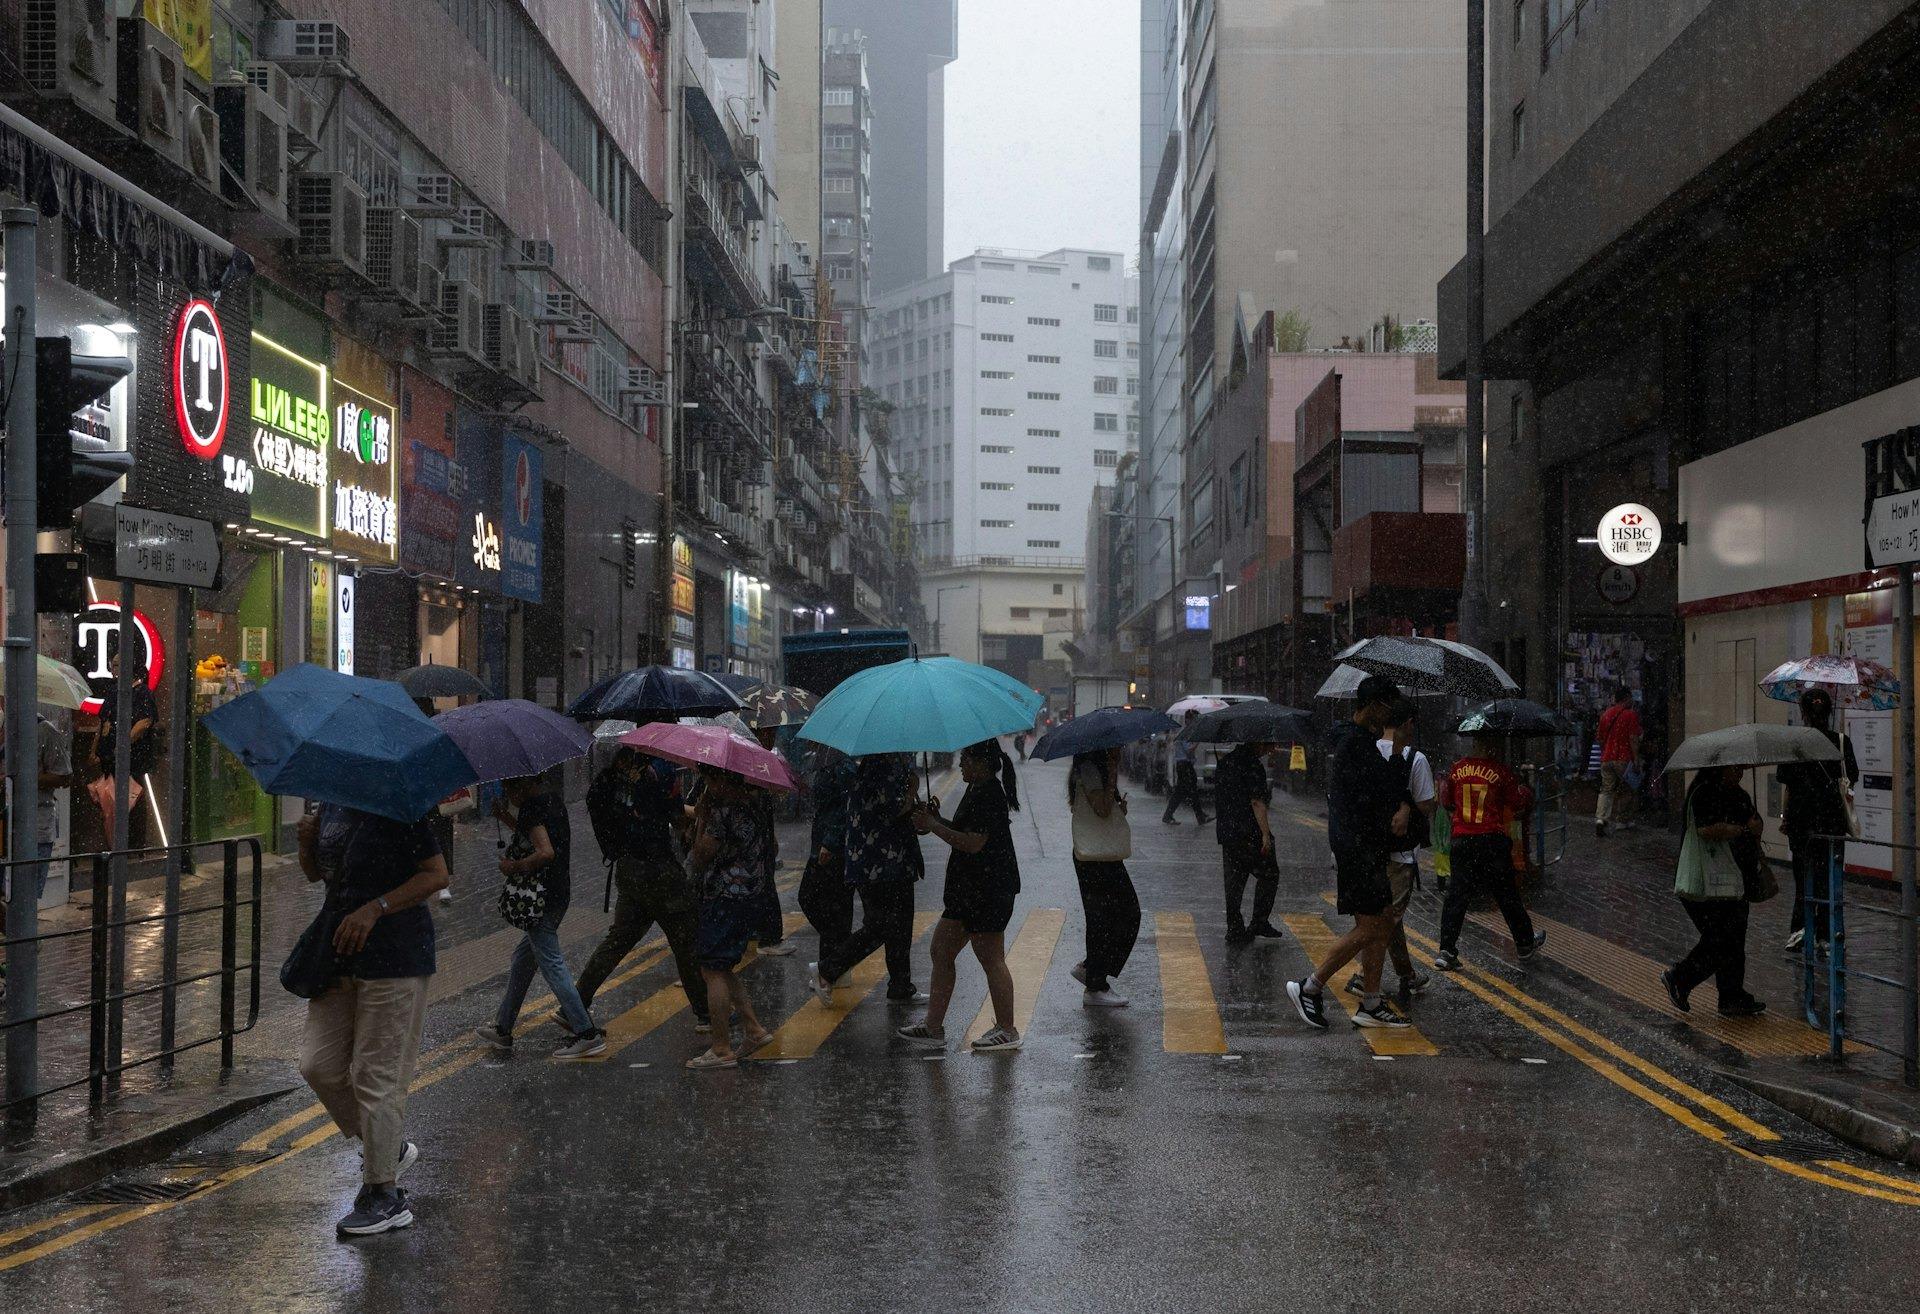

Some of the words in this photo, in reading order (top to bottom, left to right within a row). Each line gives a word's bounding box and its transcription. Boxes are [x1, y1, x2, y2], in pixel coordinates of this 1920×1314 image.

[192, 328, 217, 411] T
[1892, 503, 1909, 520] How
[119, 514, 138, 533] How
[142, 518, 164, 541] Ming
[167, 522, 194, 542] Street
[1611, 527, 1652, 540] HSBC
[1908, 528, 1919, 552] 巧
[1462, 783, 1488, 823] 17
